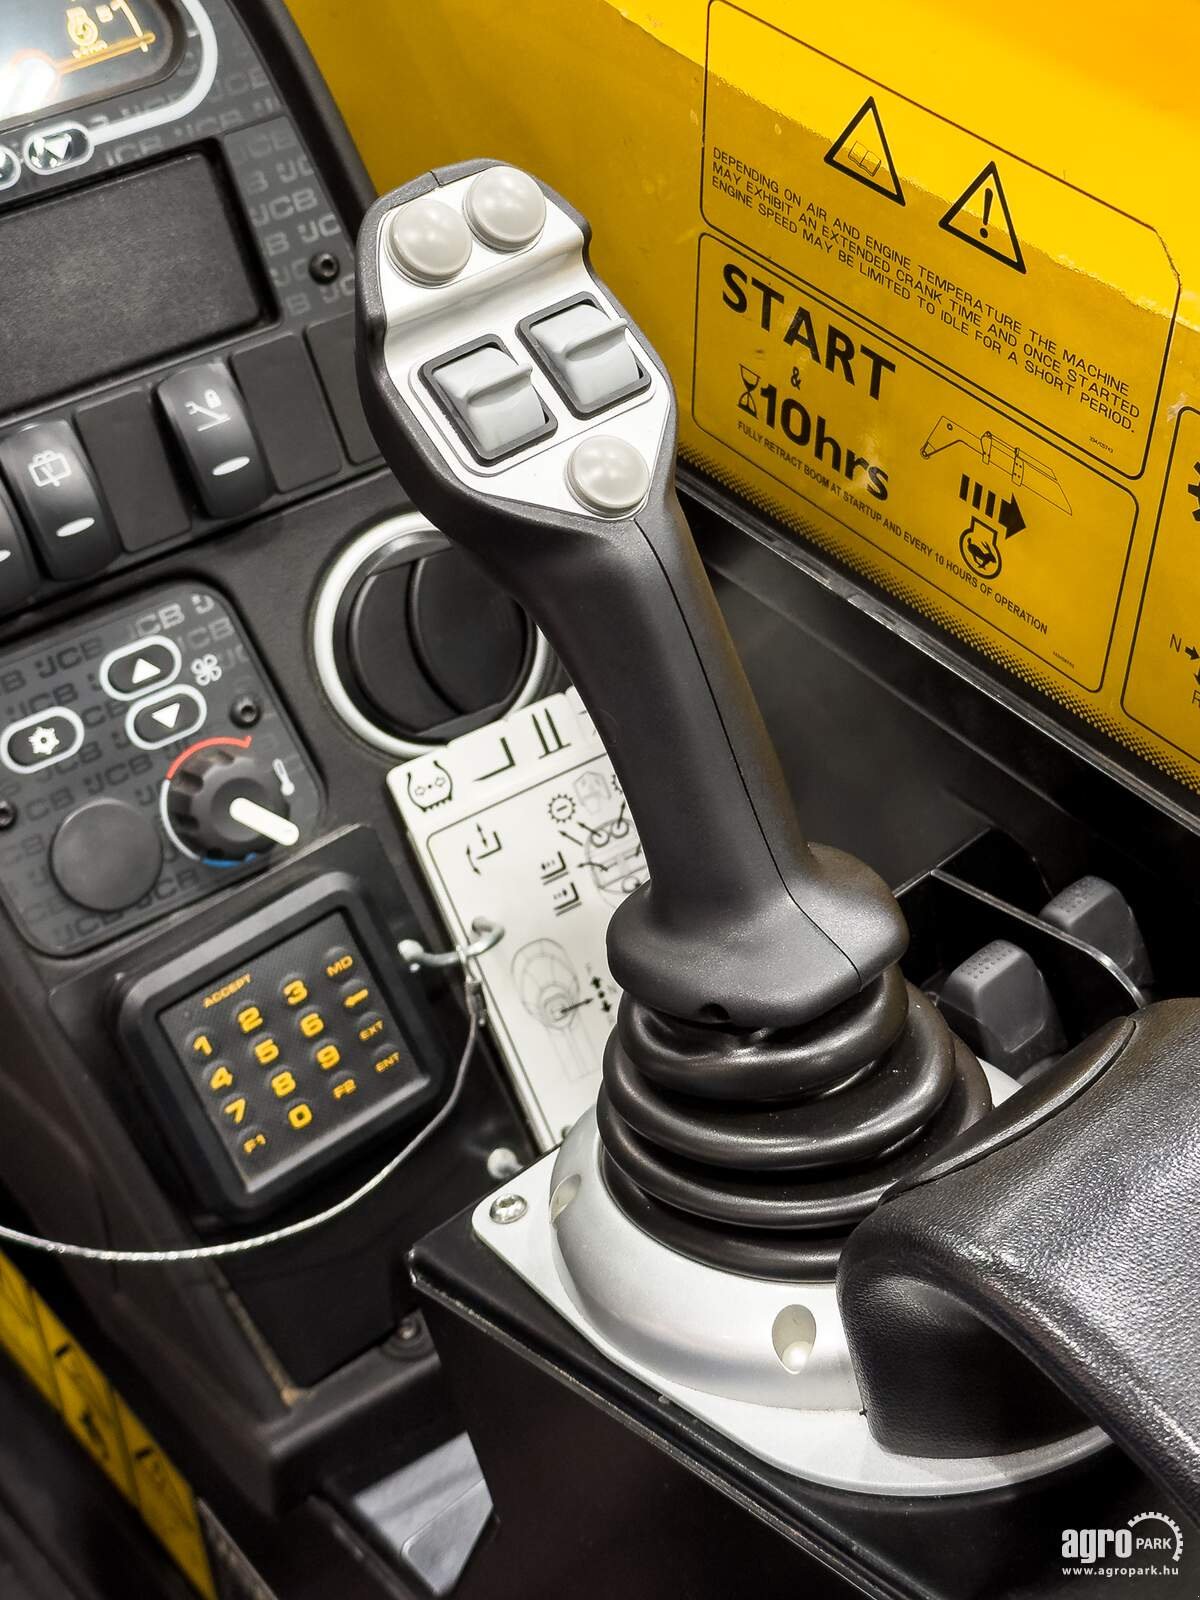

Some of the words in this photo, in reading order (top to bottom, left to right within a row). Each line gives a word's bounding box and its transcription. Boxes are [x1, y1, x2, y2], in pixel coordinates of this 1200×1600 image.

[713, 147, 779, 193] DEPENDING
[784, 189, 801, 206] ON
[806, 203, 827, 222] AIR
[833, 218, 860, 240] AND
[865, 236, 911, 270] ENGINE
[917, 264, 1022, 334] TEMPERATURE
[1029, 329, 1057, 355] THE
[1063, 350, 1129, 397] MACHINE
[712, 162, 741, 184] MAY
[746, 181, 793, 215] EXHIBIT
[799, 213, 817, 231] AN
[822, 226, 890, 273] EXTENDED
[896, 269, 943, 304] CRANK
[949, 299, 982, 327] TIME
[987, 324, 1017, 347] AND
[1023, 343, 1061, 373] ONCE
[1067, 369, 1140, 419] STARTED
[712, 177, 753, 208] ENGINE
[758, 203, 798, 234] SPEED
[803, 229, 833, 253] MAY
[838, 250, 855, 268] BE
[859, 262, 911, 300] LIMITED
[917, 295, 935, 315] TO
[940, 310, 969, 336] IDLE
[975, 330, 1001, 354] FOR
[1008, 352, 1018, 365] A
[1024, 360, 1075, 396] SHORT
[1080, 392, 1135, 433] PERIOD.
[722, 263, 896, 401] START
[790, 366, 801, 390] &
[760, 383, 889, 501] 10hrs
[737, 421, 763, 444] FULLY
[764, 438, 804, 471] RETRACT
[804, 465, 829, 488] BOOM
[830, 482, 841, 496] AT
[843, 490, 882, 522] STARTUP
[883, 518, 902, 537] AND
[904, 532, 933, 557] EVERY
[935, 552, 944, 565] 10
[946, 559, 978, 588] HOURS
[980, 583, 993, 597] OF
[995, 592, 1048, 634] OPERATION
[1169, 633, 1181, 653] N
[203, 973, 251, 1008] ACCEPT
[283, 980, 307, 1004] 3
[238, 1007, 263, 1032] 2
[299, 1013, 324, 1037] 6
[194, 1036, 212, 1055] 1
[255, 1039, 279, 1064] 5
[315, 1045, 340, 1069] 9
[210, 1066, 233, 1089] 4
[271, 1071, 296, 1097] 8
[224, 1098, 246, 1123] 7
[288, 1104, 312, 1128] 0
